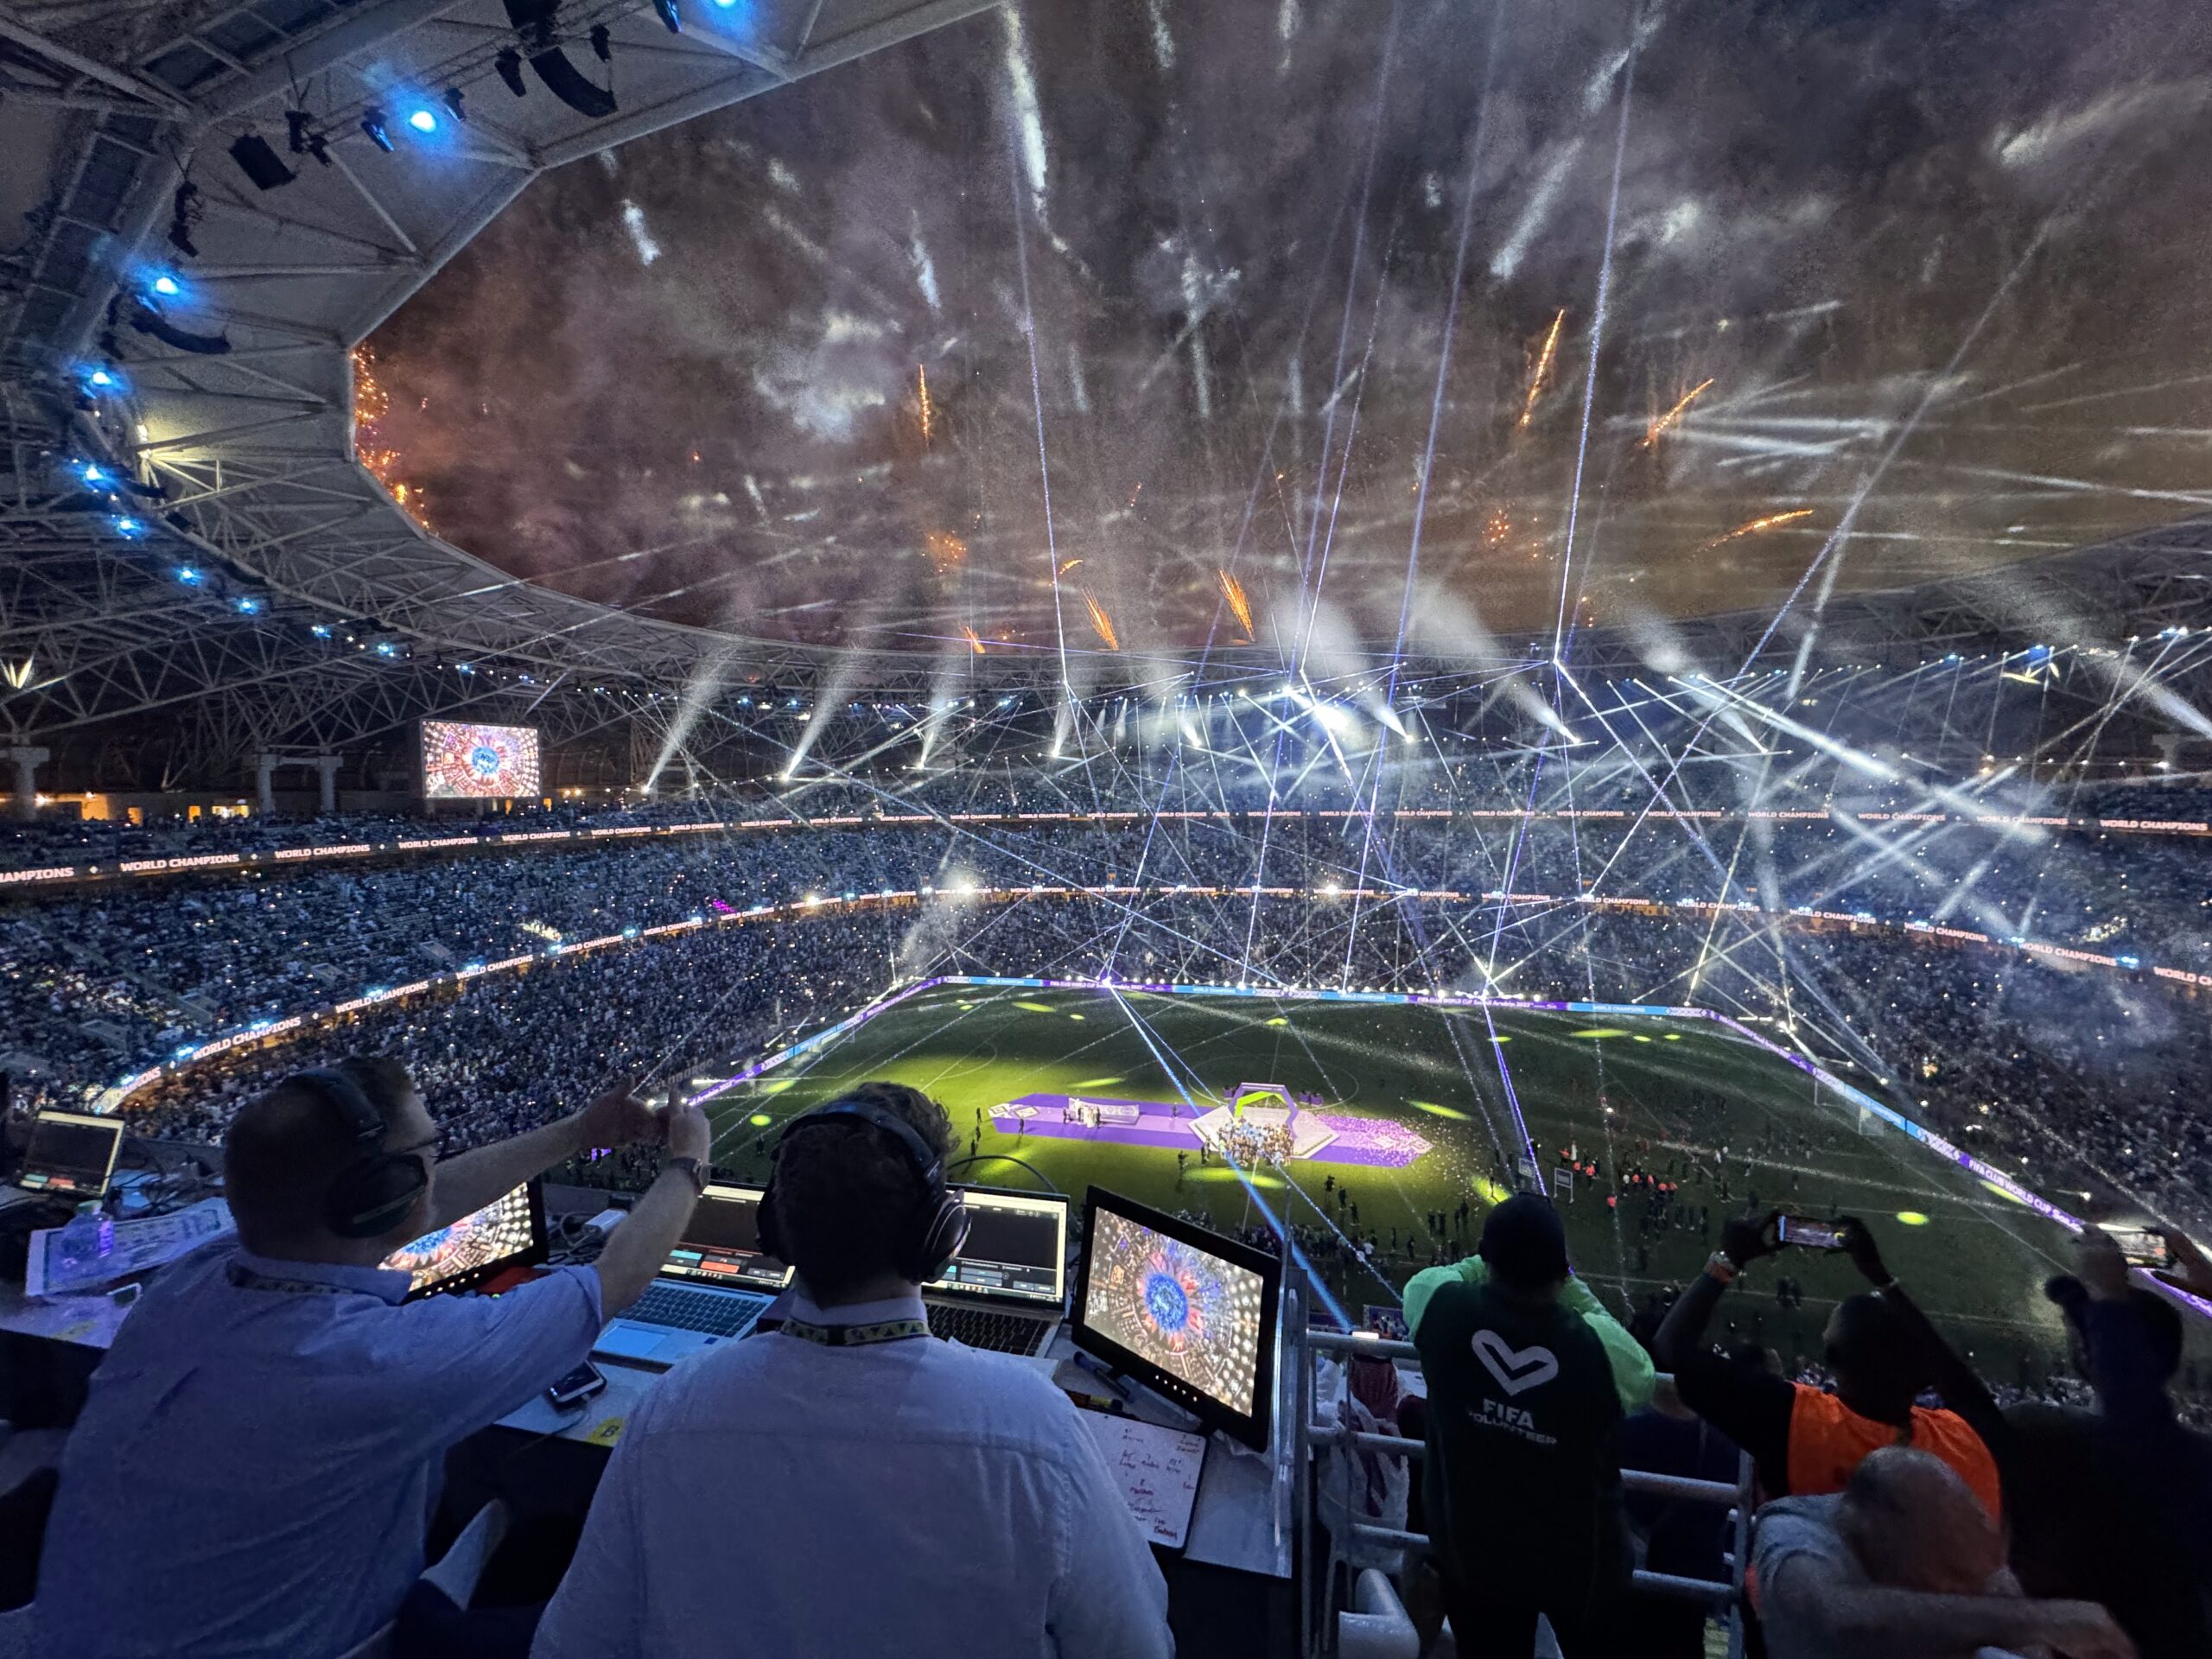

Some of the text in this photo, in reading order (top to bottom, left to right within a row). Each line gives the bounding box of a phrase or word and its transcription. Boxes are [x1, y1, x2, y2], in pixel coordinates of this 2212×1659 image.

[1778, 810, 1829, 819] CHAMPIONS
[1857, 812, 1947, 823] WORLD CHAMPIONS
[1977, 816, 2069, 826] WORLD CHAMPIONS
[615, 826, 652, 835] CHAMPIONS
[2100, 819, 2209, 832] WORLD CHAMPIONS
[398, 836, 478, 849] WORLD CHAMPIONS
[529, 831, 570, 840] CHAMPIONS
[275, 844, 371, 860] WORLD CHAMPIONS
[120, 854, 239, 872] WORLD CHAMPIONS
[880, 890, 917, 899] CHAMPIONS
[1420, 890, 1460, 899] CHAMPIONS
[1508, 893, 1551, 902] CHAMPIONS
[1575, 895, 1650, 906] WORLD CHAMPIONS
[720, 906, 775, 921] WORLD CHAMPIONS
[1676, 900, 1761, 913] WORLD CHAMPIONS
[1789, 908, 1877, 925] WORLD CHAMPIONS
[644, 919, 703, 937] WORLD CHAMPIONS
[1904, 921, 1988, 943] WORLD CHAMPIONS
[557, 934, 624, 955] WORLD CHAMPIONS
[2054, 947, 2118, 967] CHAMPIONS
[456, 954, 534, 981] WORLD CHAMPIONS
[2152, 965, 2197, 983] WORLD
[335, 981, 429, 1014] WORLD CHAMPIONS
[192, 1017, 302, 1060] WORLD CHAMPIONS
[1968, 1159, 1986, 1176] FIFA
[1985, 1169, 2006, 1186] CLUB
[2004, 1179, 2034, 1205] WORLD
[2033, 1198, 2052, 1215] CUP
[1483, 1398, 1535, 1430] FIFA
